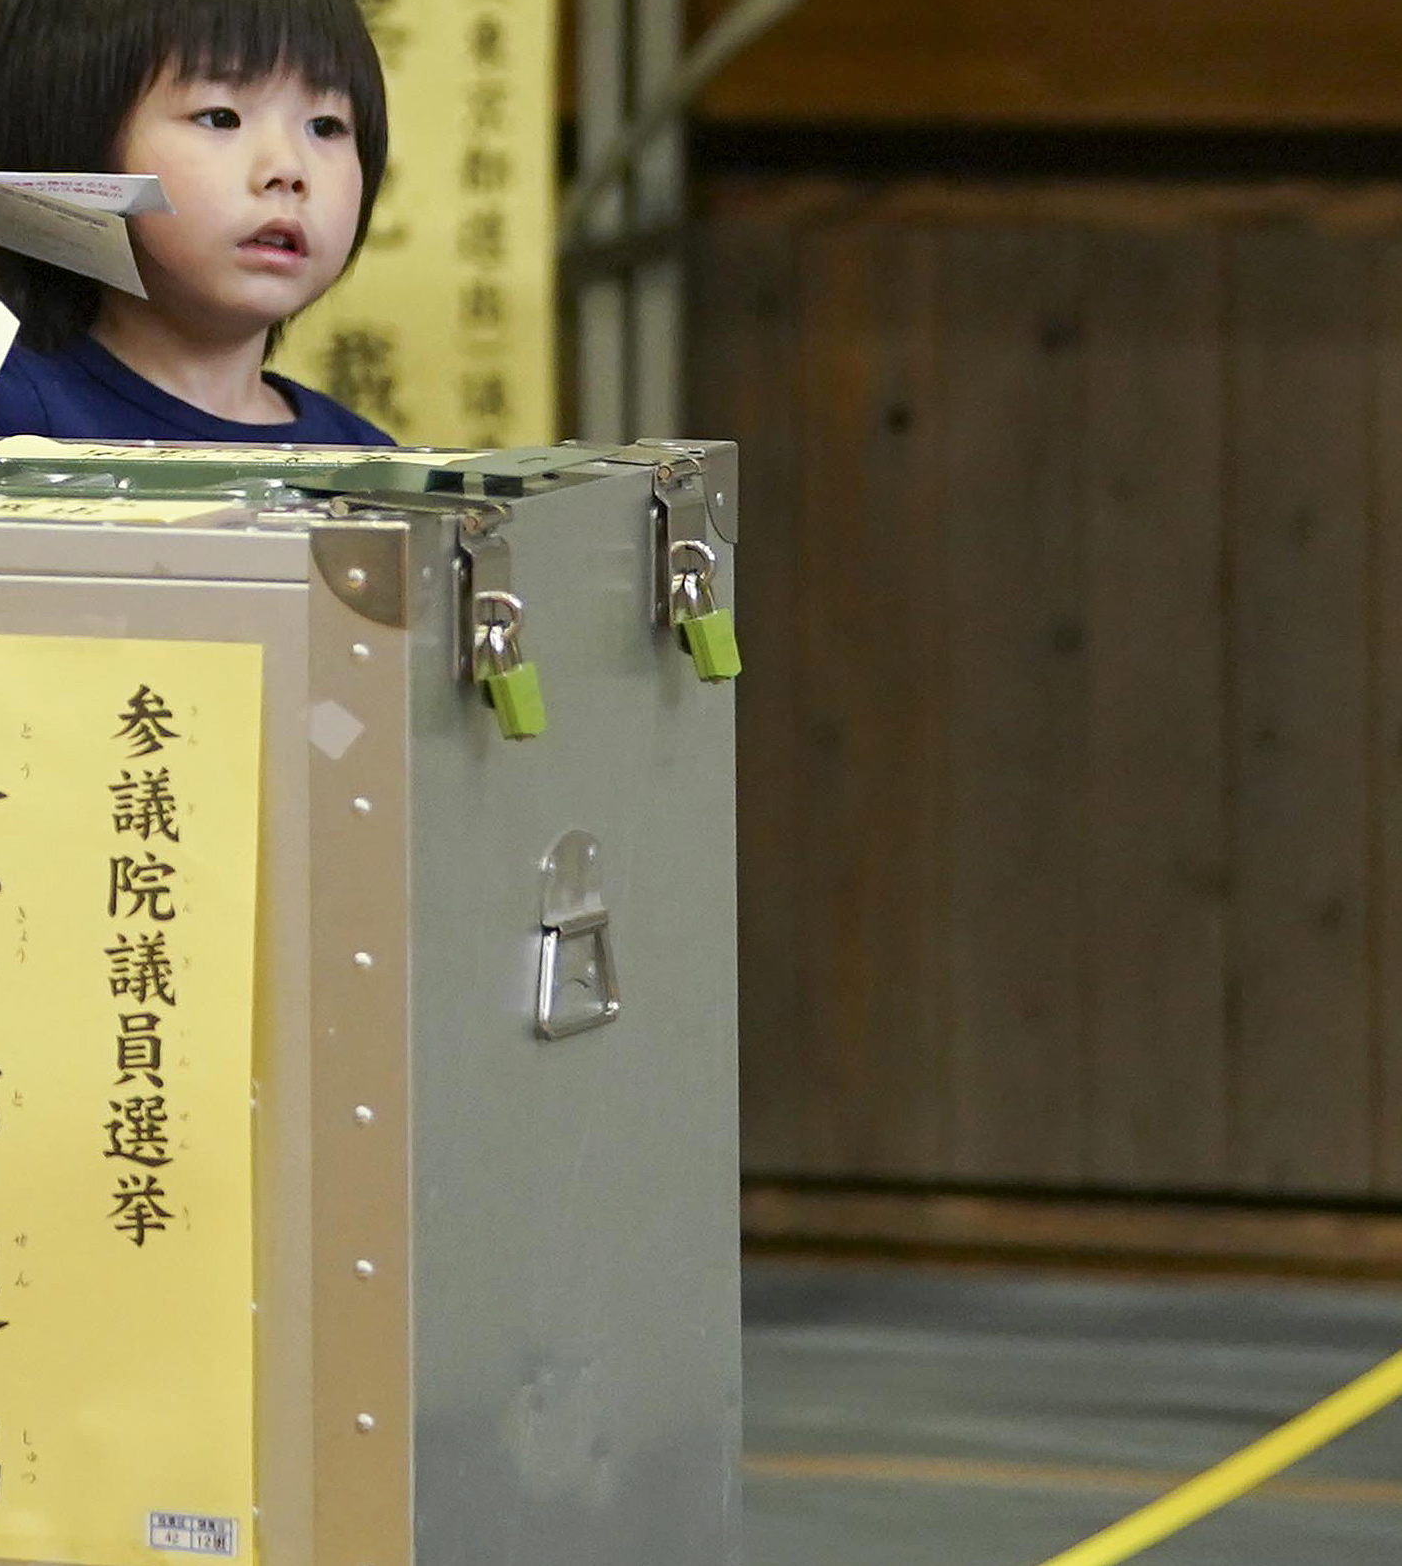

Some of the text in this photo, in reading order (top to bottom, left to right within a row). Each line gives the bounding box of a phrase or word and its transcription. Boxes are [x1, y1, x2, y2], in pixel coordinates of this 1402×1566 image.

[102, 683, 182, 1247] 参議院議員選挙
